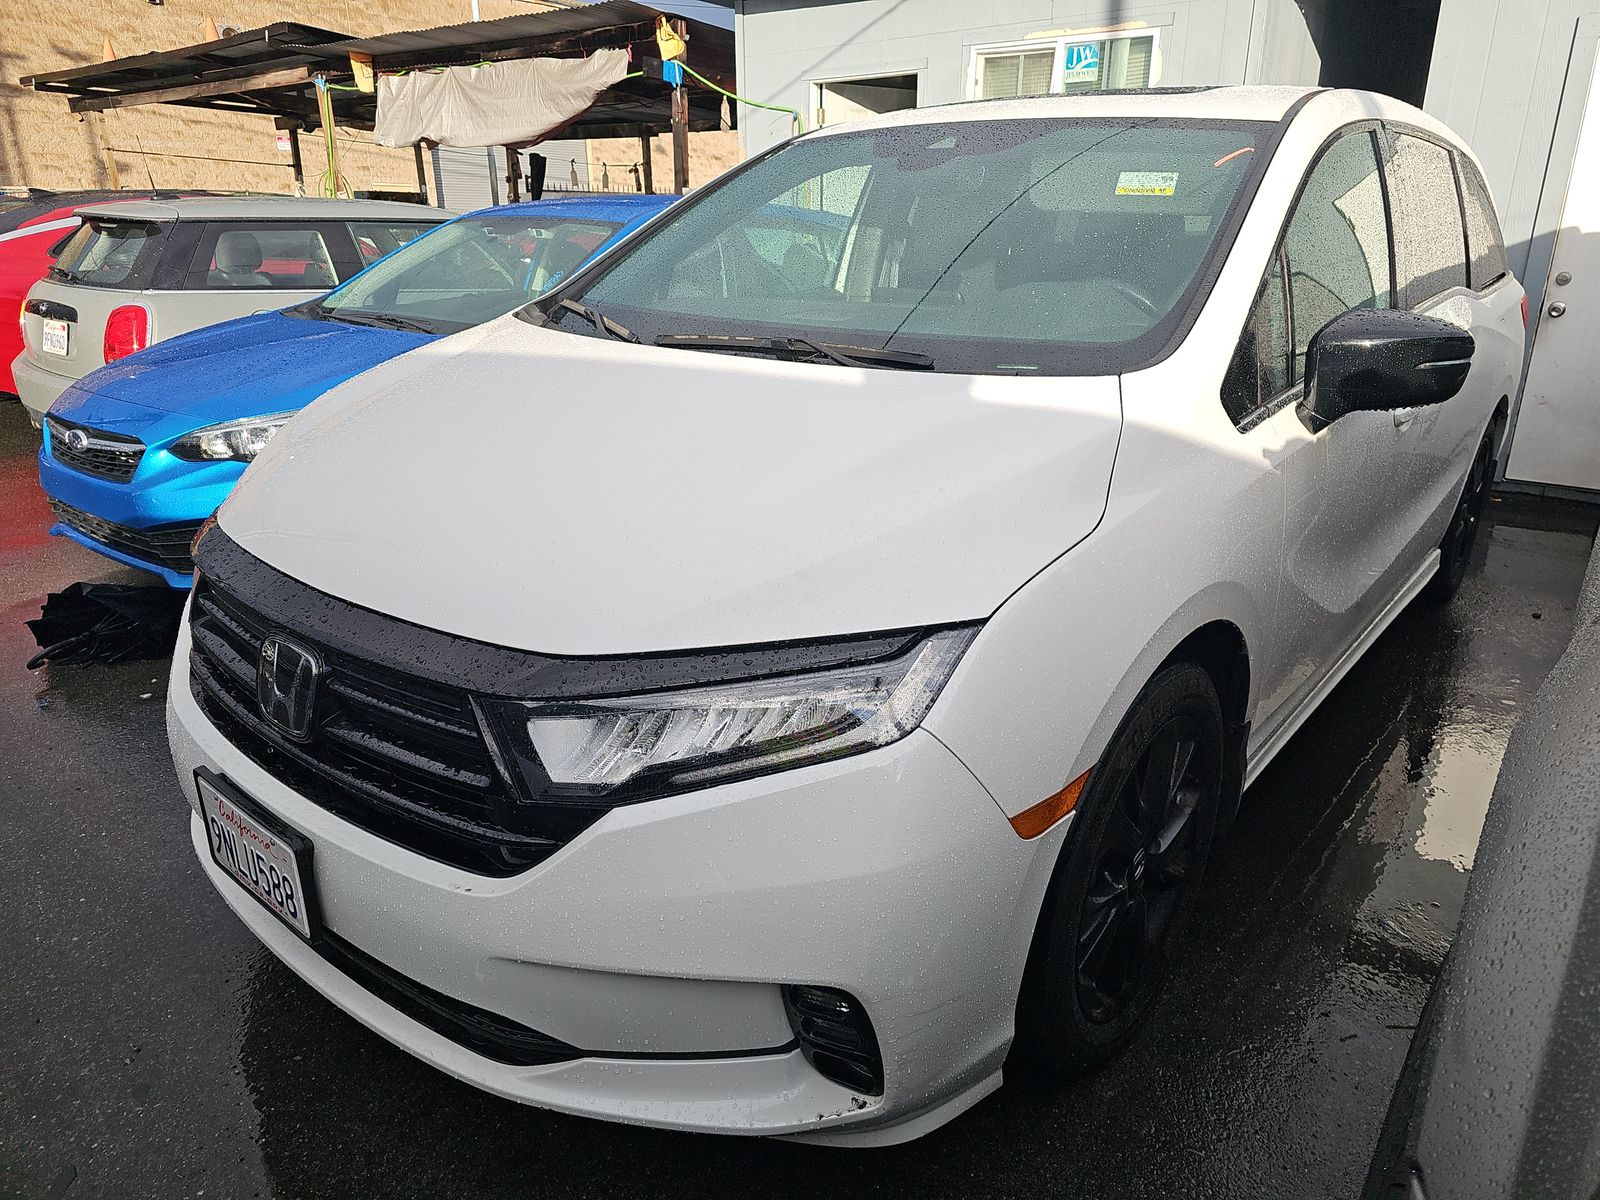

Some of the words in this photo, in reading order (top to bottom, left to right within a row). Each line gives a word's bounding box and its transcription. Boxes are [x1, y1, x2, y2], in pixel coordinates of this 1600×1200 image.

[1068, 45, 1094, 68] JW
[217, 799, 279, 860] California
[210, 815, 298, 919] 9NLU588
